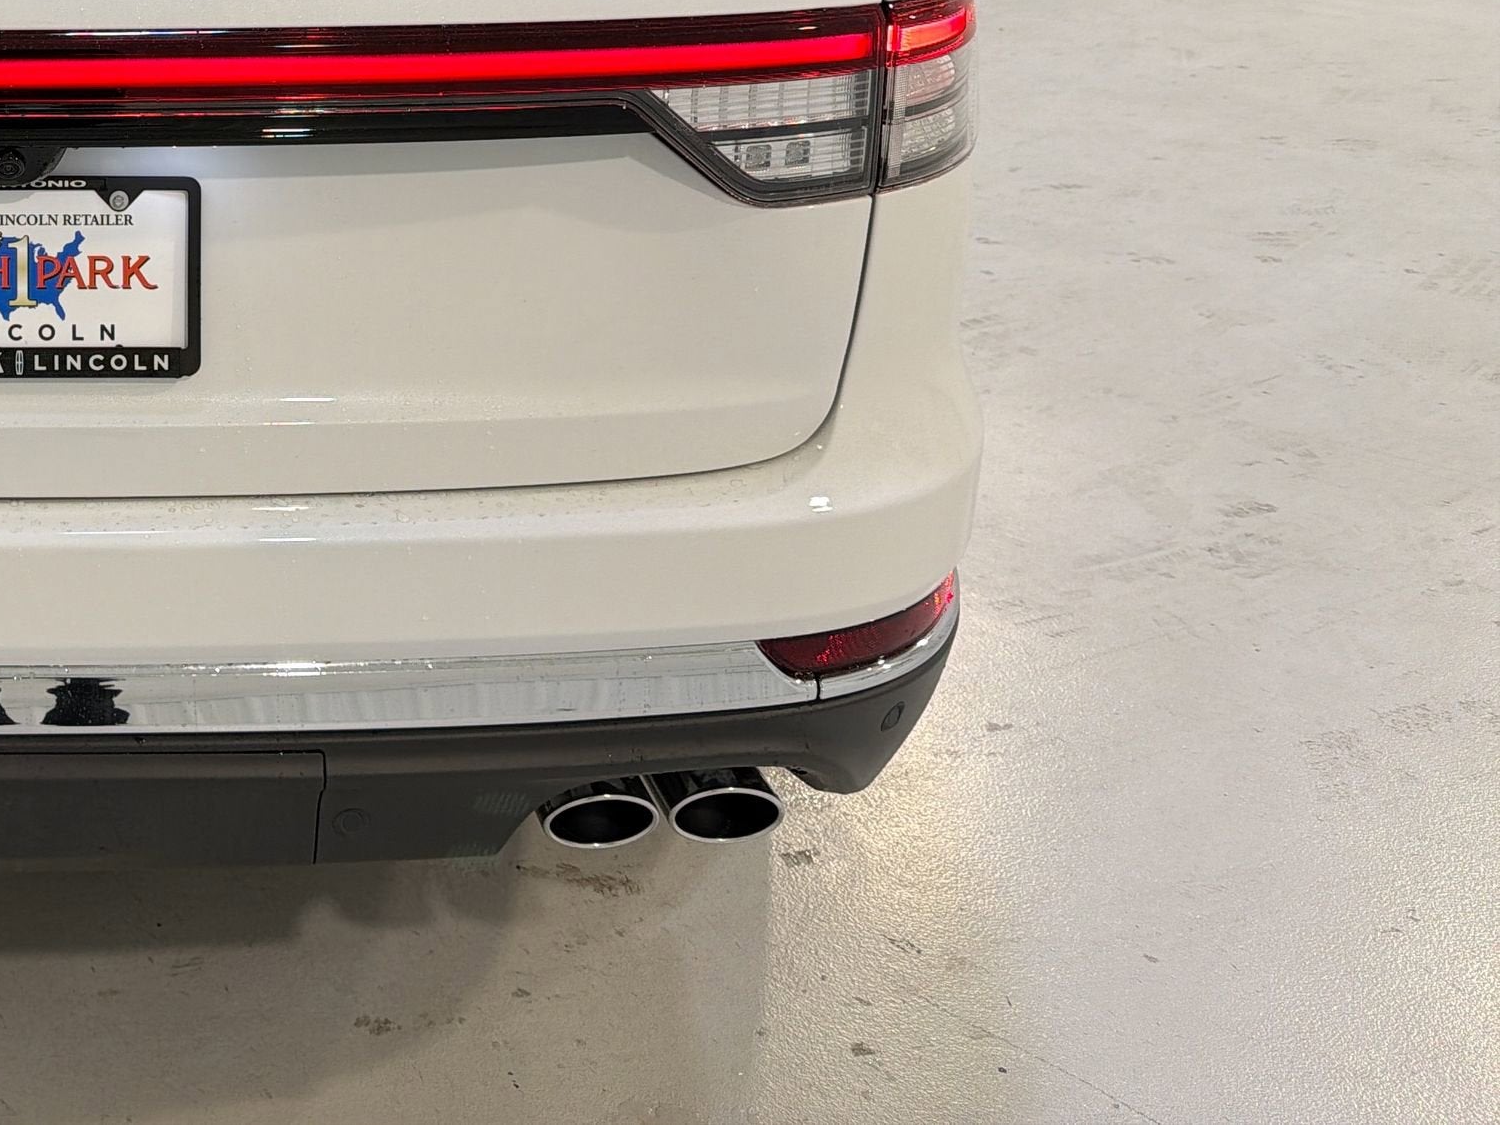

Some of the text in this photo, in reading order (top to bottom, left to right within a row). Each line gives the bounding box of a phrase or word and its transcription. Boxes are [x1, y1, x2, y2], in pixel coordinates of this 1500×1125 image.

[62, 214, 134, 227] RETAILER
[35, 254, 159, 291] PARK
[33, 354, 170, 371] LINCOLN
